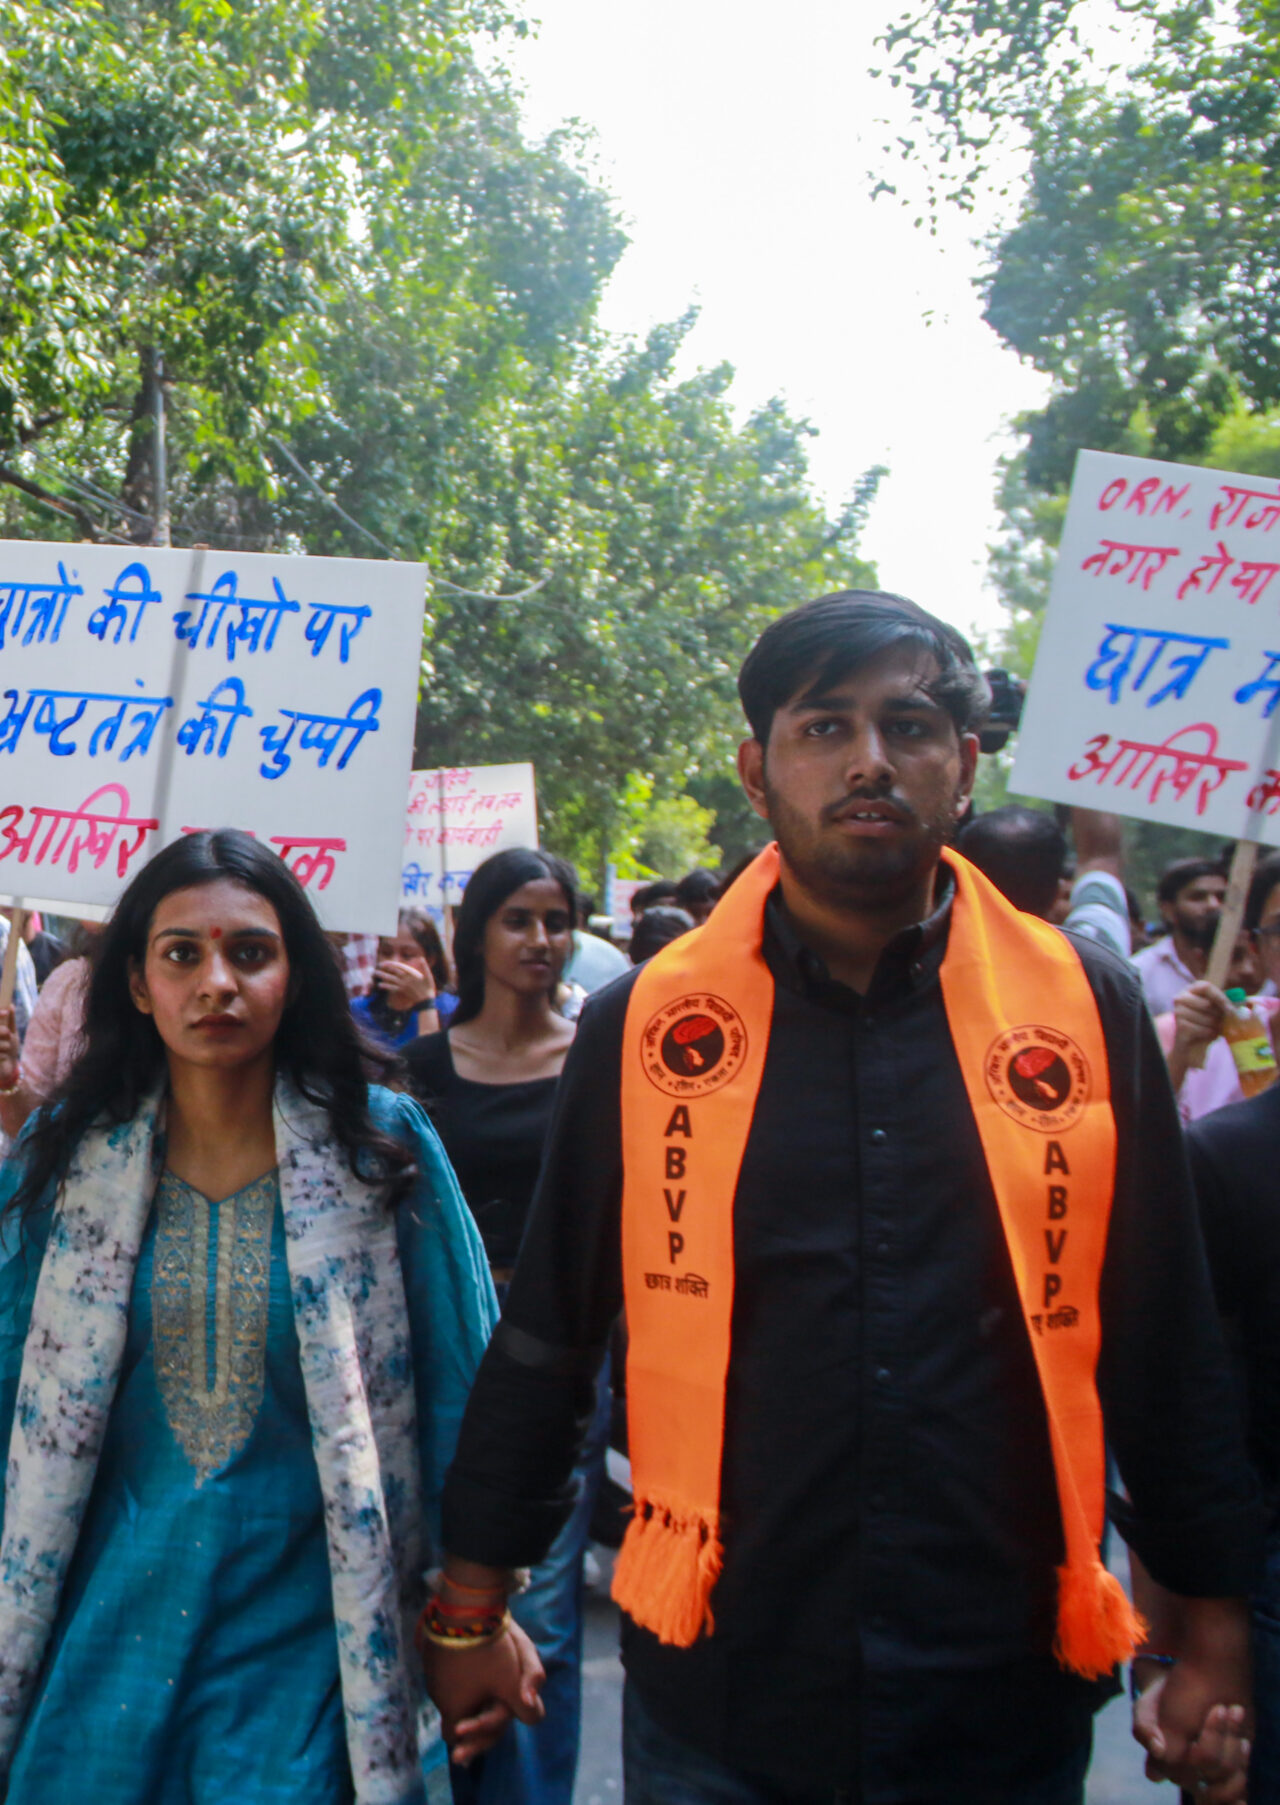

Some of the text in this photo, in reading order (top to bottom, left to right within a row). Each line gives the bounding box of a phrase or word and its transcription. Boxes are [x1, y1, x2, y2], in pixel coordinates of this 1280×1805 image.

[88, 563, 162, 645] की
[305, 602, 372, 663] पर
[1081, 539, 1180, 591] नगर
[1085, 622, 1230, 709] छात्र
[177, 676, 253, 758] की
[258, 688, 382, 779] चुप्पी
[1067, 722, 1249, 816] आखिर
[663, 1104, 692, 1265] ABVP
[1044, 1140, 1070, 1309] ABVP
[675, 1272, 709, 1299] शक्ति
